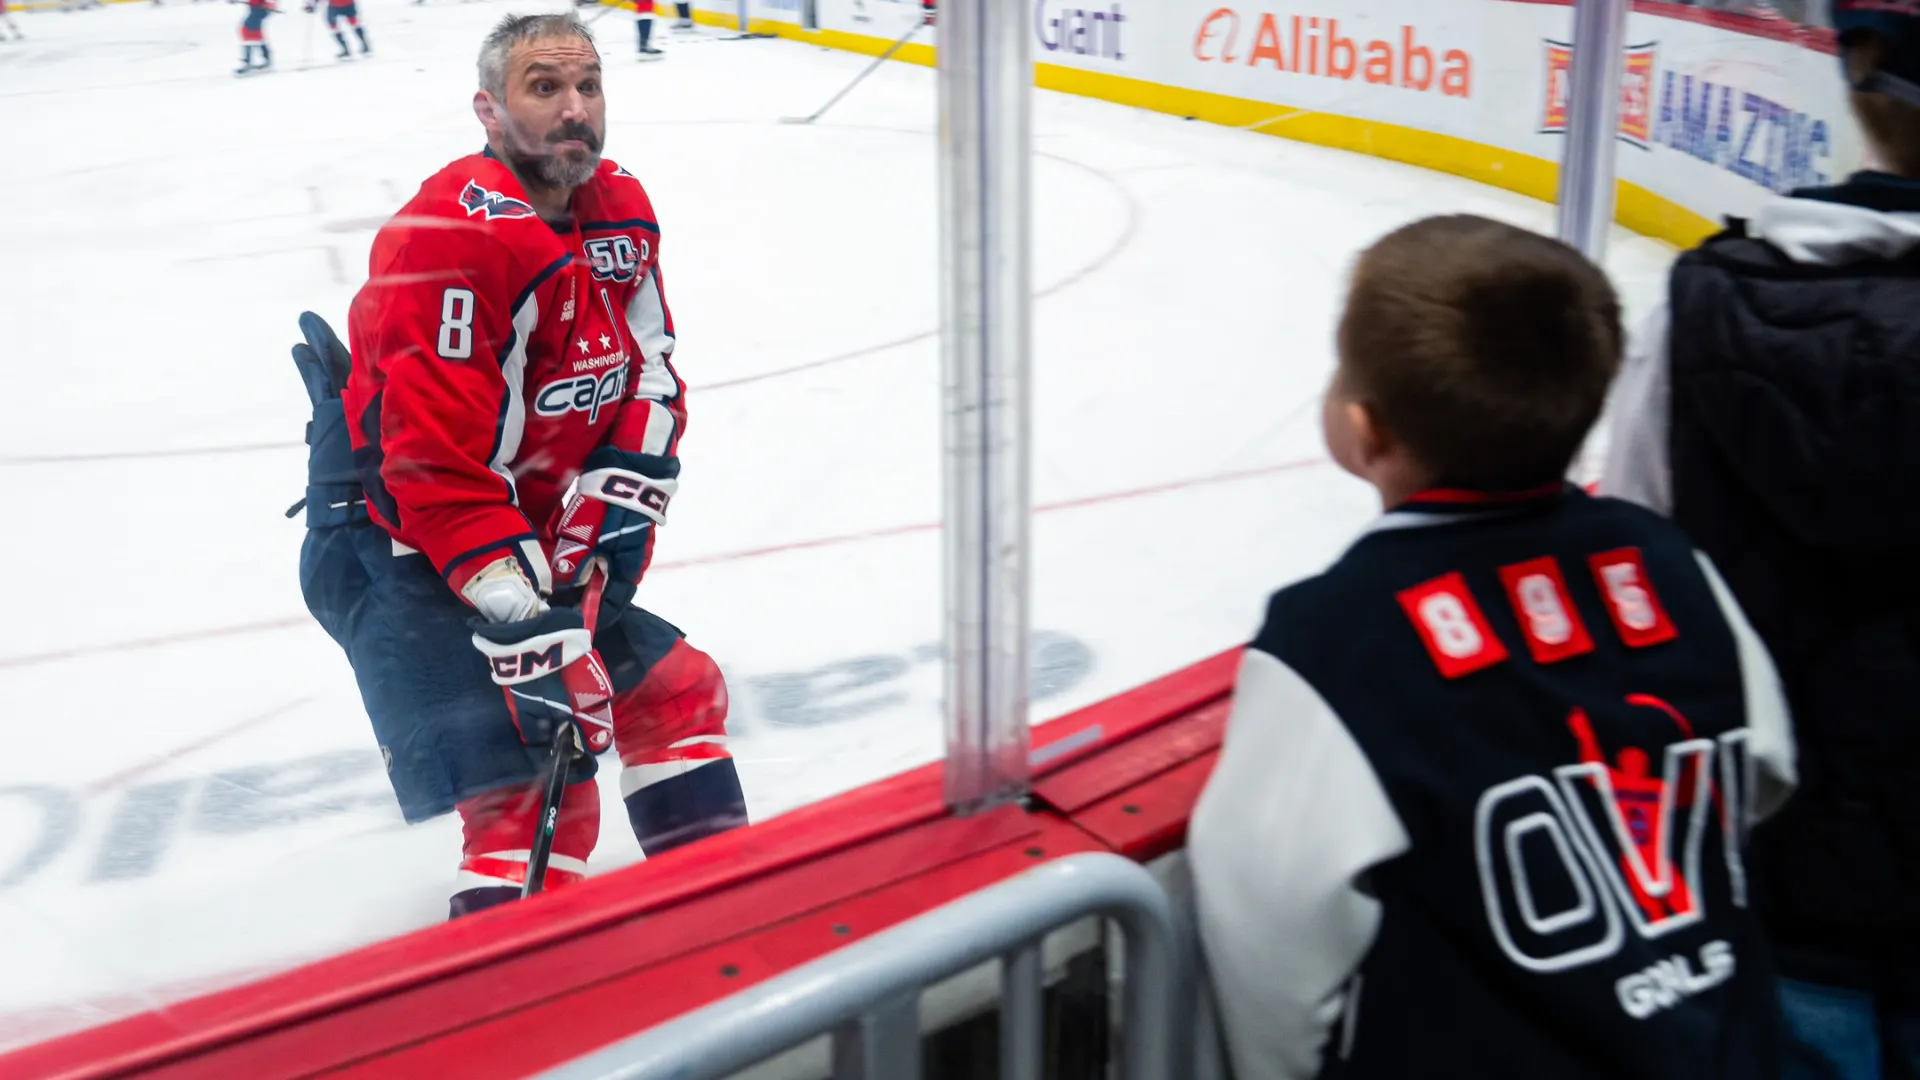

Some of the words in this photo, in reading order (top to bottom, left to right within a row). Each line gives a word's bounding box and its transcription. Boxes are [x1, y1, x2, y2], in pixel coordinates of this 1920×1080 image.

[1247, 12, 1472, 99] Alibaba
[437, 287, 475, 359] 8
[600, 474, 670, 517] CC
[489, 640, 565, 679] CM
